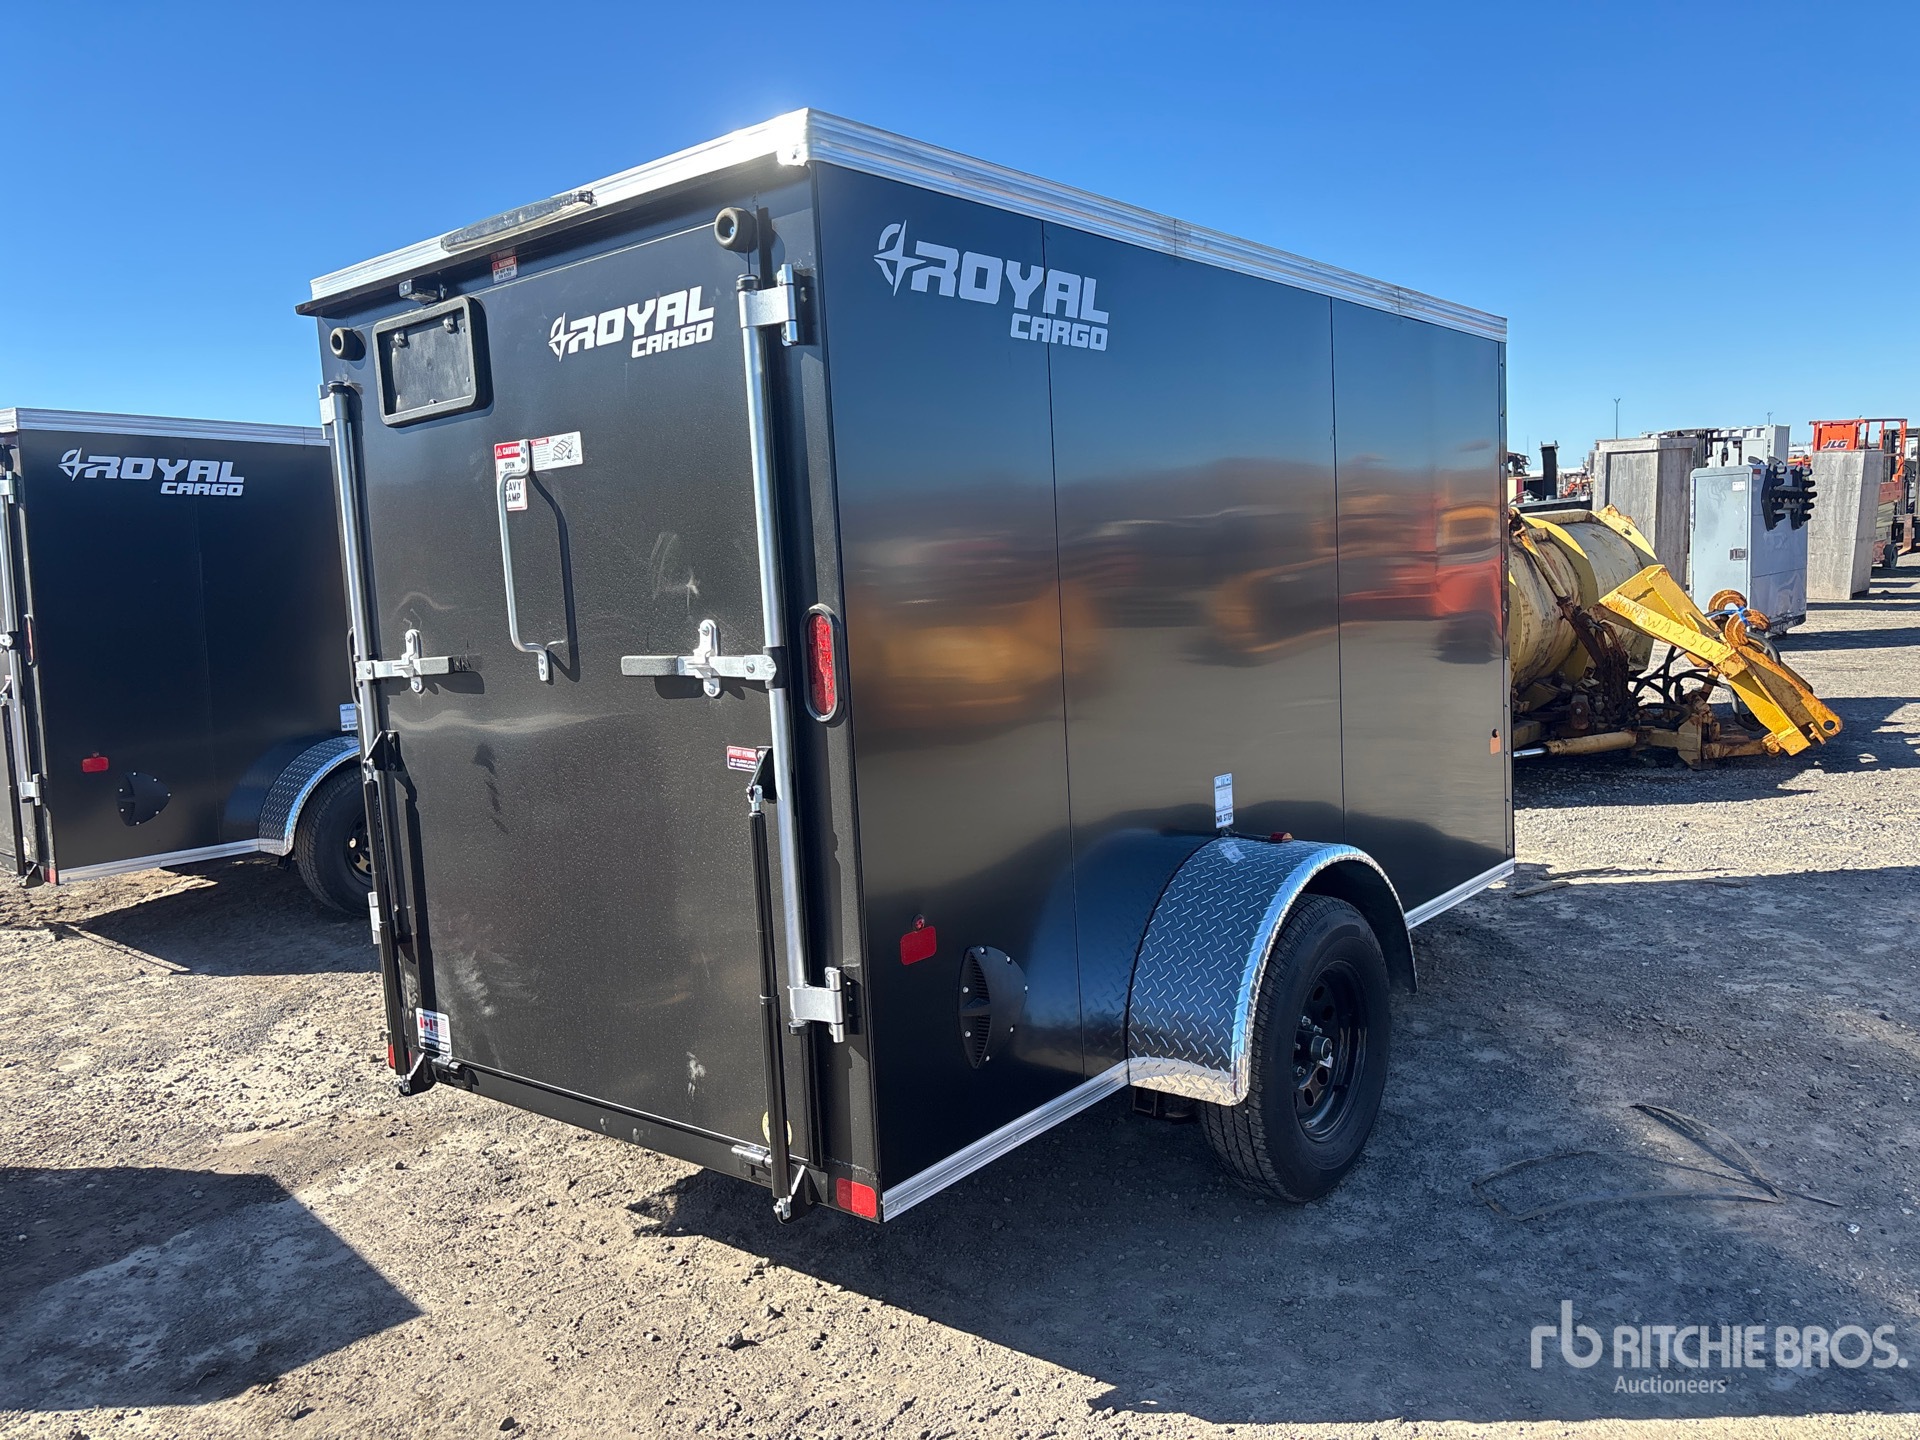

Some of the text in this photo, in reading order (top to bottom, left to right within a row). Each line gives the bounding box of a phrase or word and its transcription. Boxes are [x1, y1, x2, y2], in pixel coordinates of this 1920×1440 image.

[911, 240, 1109, 324] ROYAL
[568, 286, 715, 354] ROYAL
[1010, 312, 1108, 351] CARGO
[631, 321, 714, 359] CARGO
[502, 446, 520, 455] CAUTIO
[1822, 439, 1848, 449] JLG
[84, 456, 244, 483] ROYAL
[160, 482, 244, 496] CARGO
[505, 481, 521, 491] EAVY
[506, 493, 520, 502] AMP
[1216, 812, 1232, 823] NO STEP
